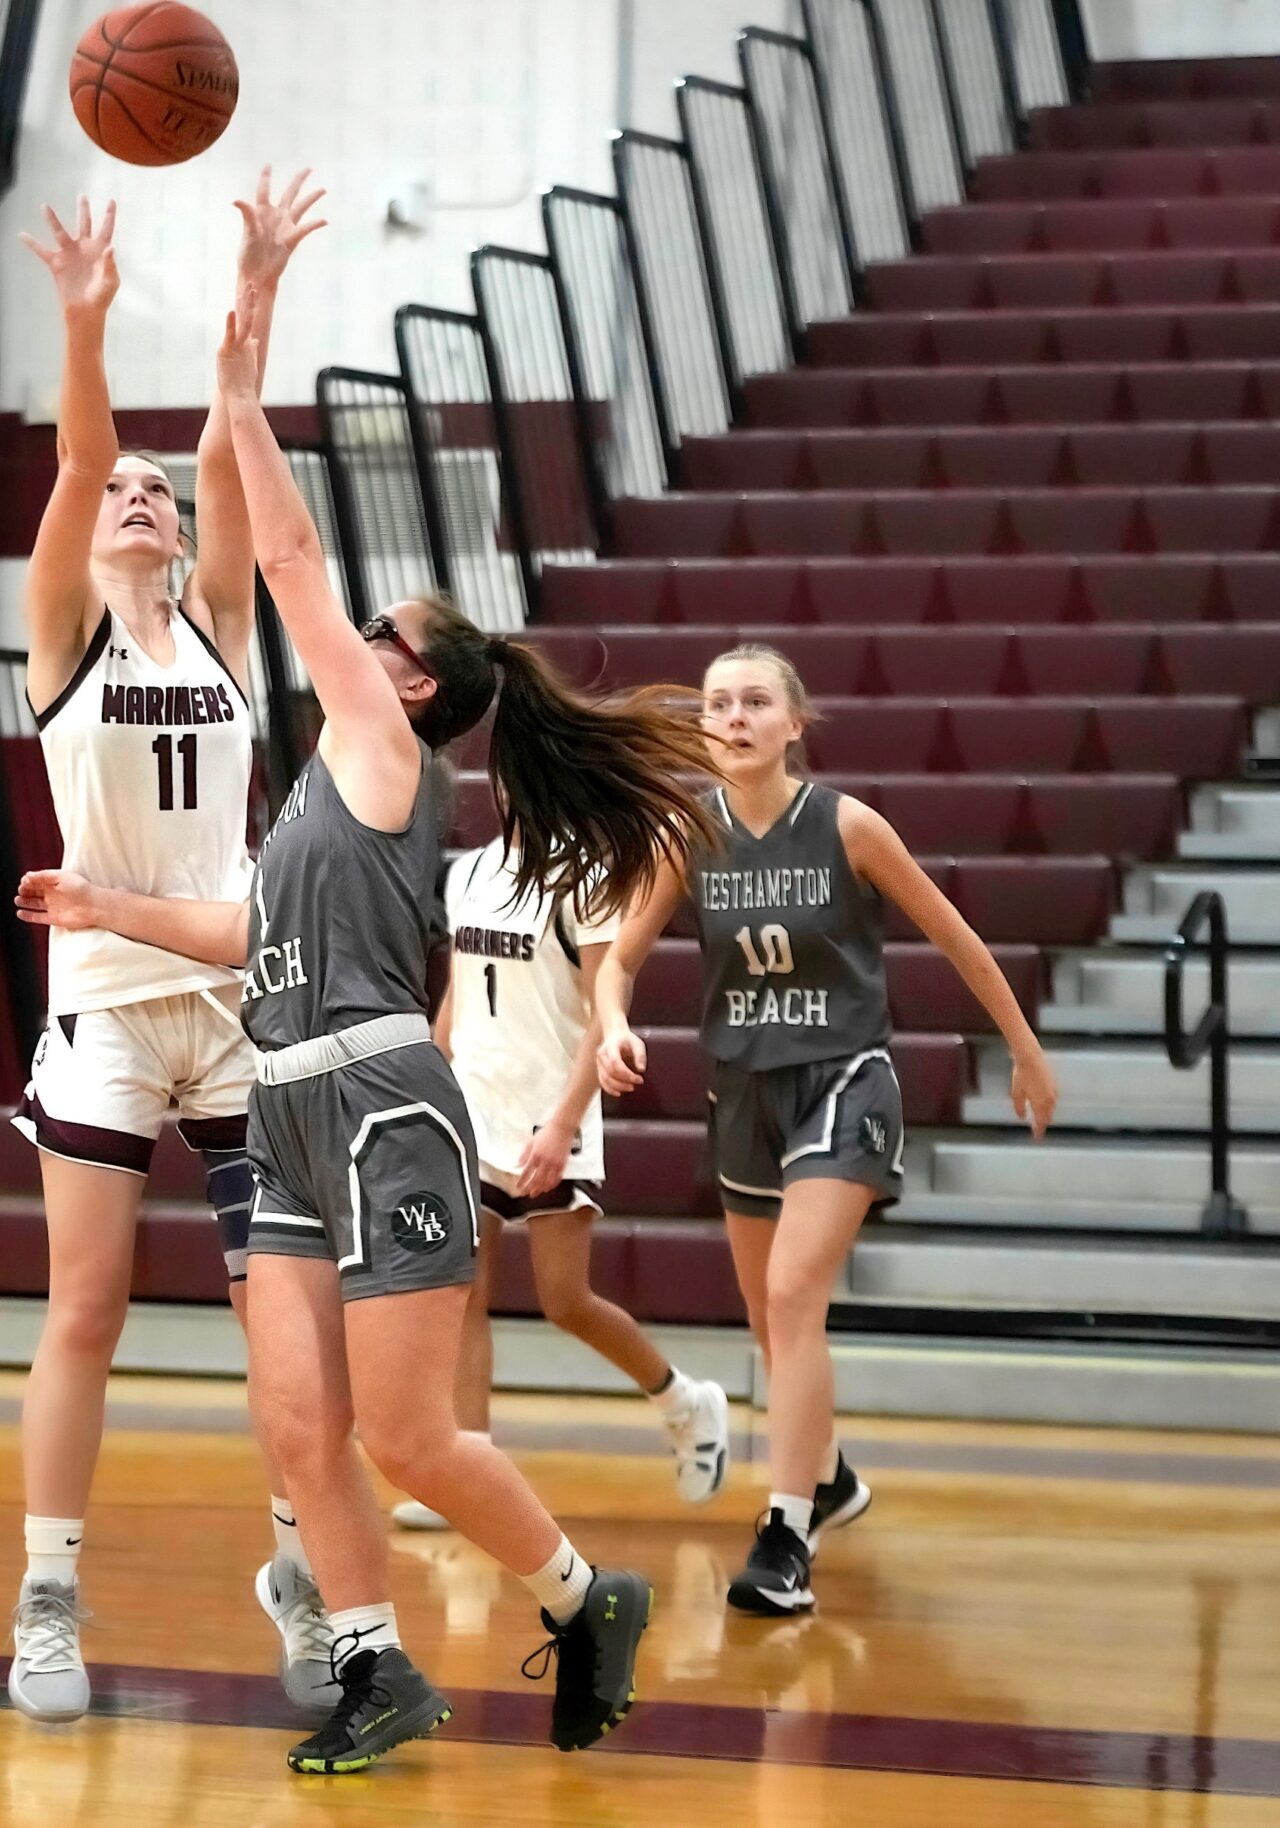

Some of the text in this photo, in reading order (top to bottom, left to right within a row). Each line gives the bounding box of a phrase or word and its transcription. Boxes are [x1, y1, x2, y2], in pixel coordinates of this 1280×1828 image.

[101, 683, 235, 726] MARINERS
[152, 733, 198, 811] 11
[735, 924, 796, 977] 10
[483, 963, 497, 1018] 1
[725, 988, 830, 1029] BEACH
